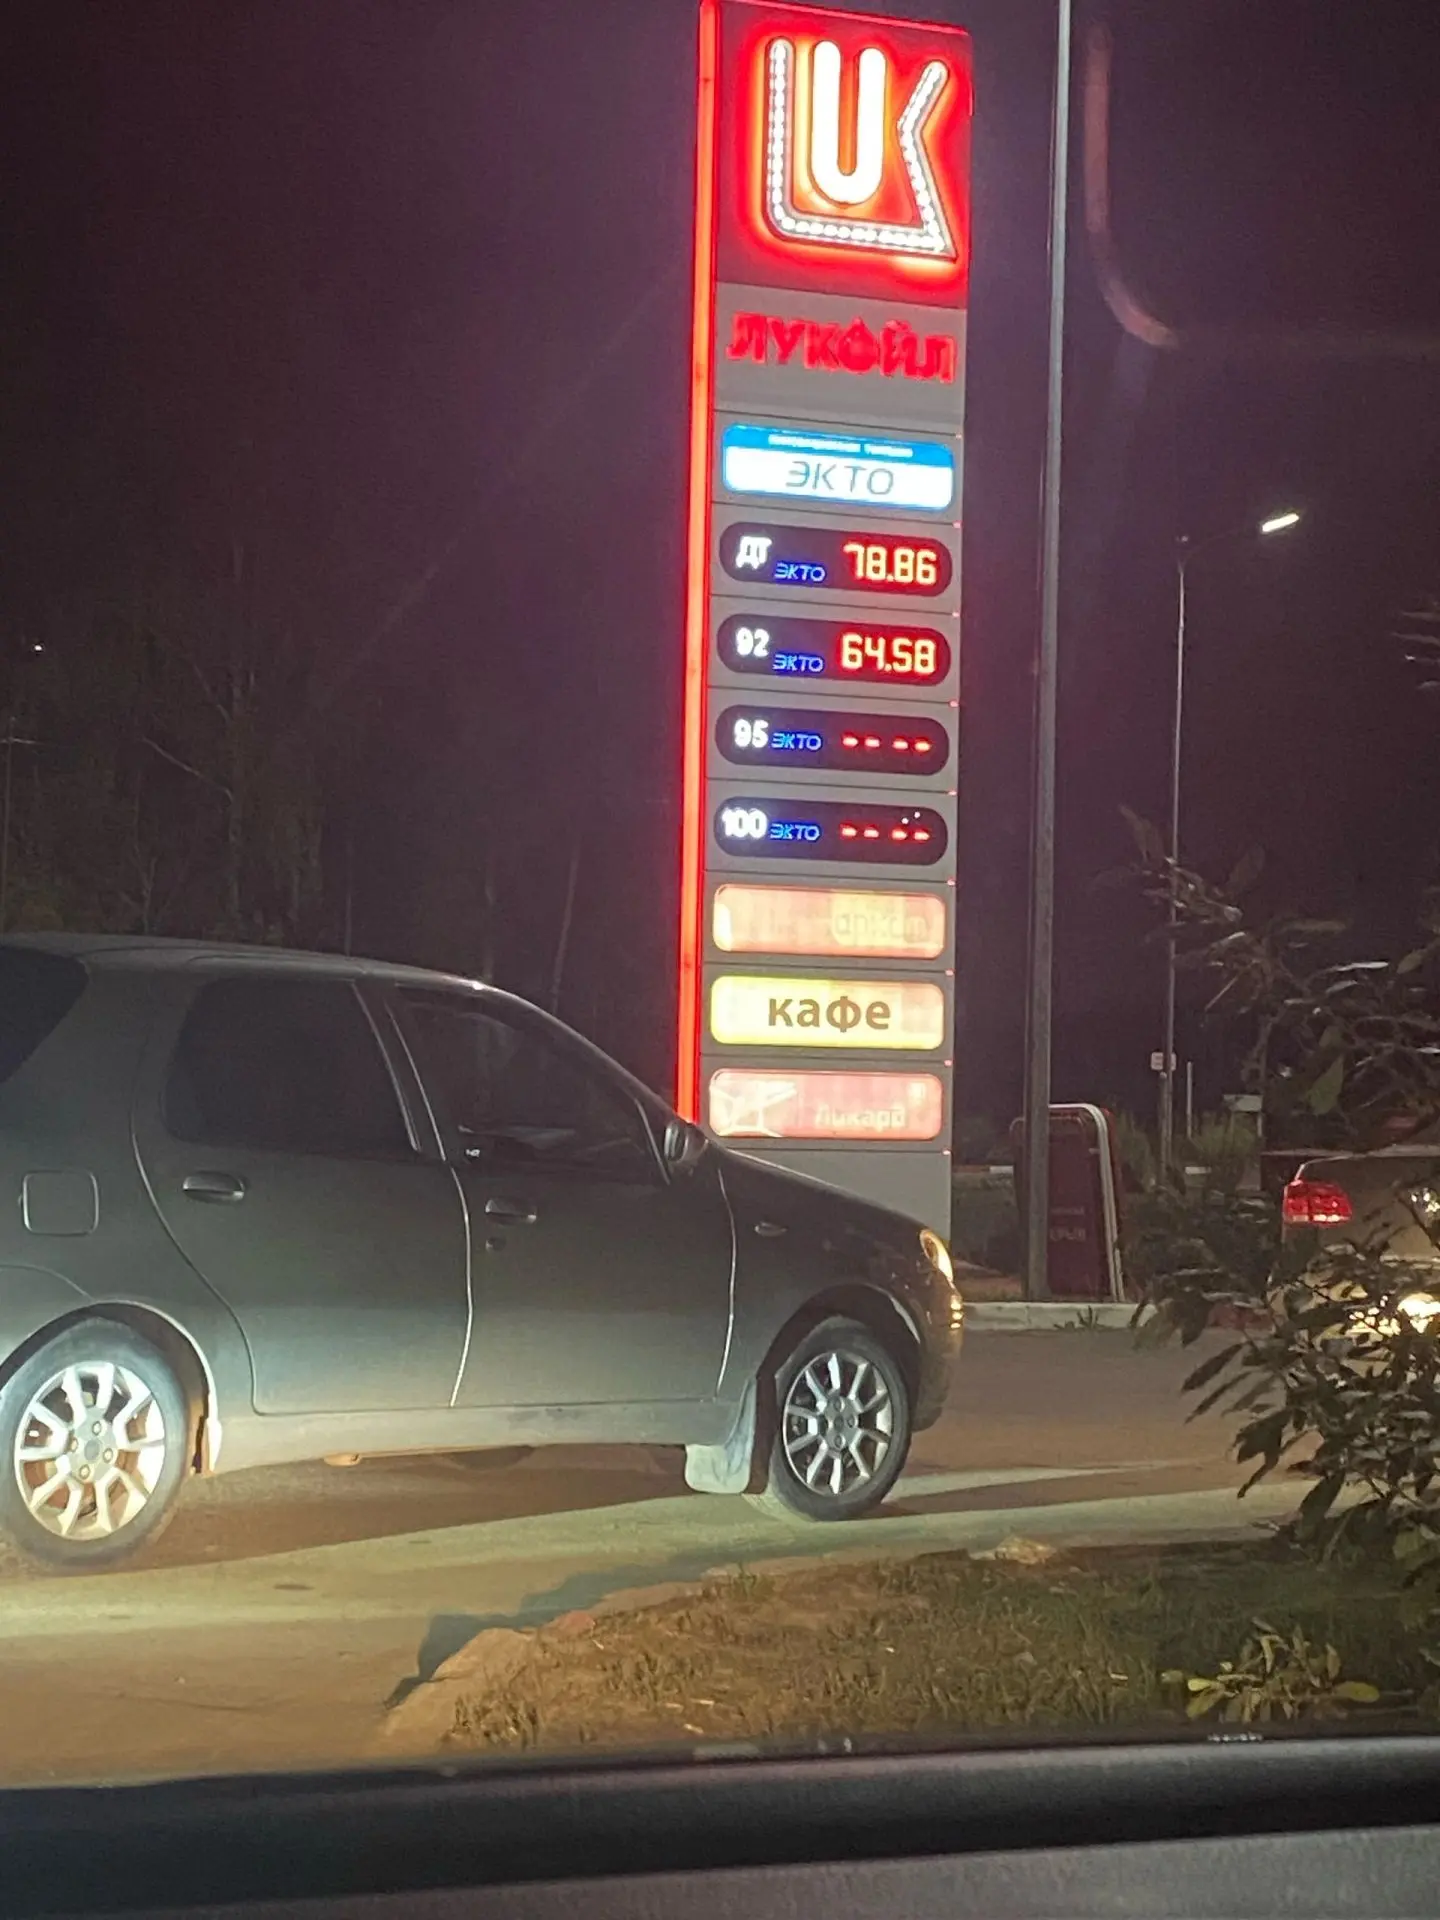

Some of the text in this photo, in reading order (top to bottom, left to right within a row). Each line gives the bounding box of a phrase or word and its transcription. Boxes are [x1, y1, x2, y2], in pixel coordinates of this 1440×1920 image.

[728, 312, 955, 383] ЛУКОЙЛ
[785, 460, 894, 495] ЭКТО
[735, 536, 937, 585] ДТ ЭКТО 78.86
[735, 628, 936, 674] 92 ЭКТО 64.58
[733, 719, 822, 750] 95 ЭКТО
[721, 808, 821, 841] 100 ЭКТО
[768, 996, 891, 1032] кафе
